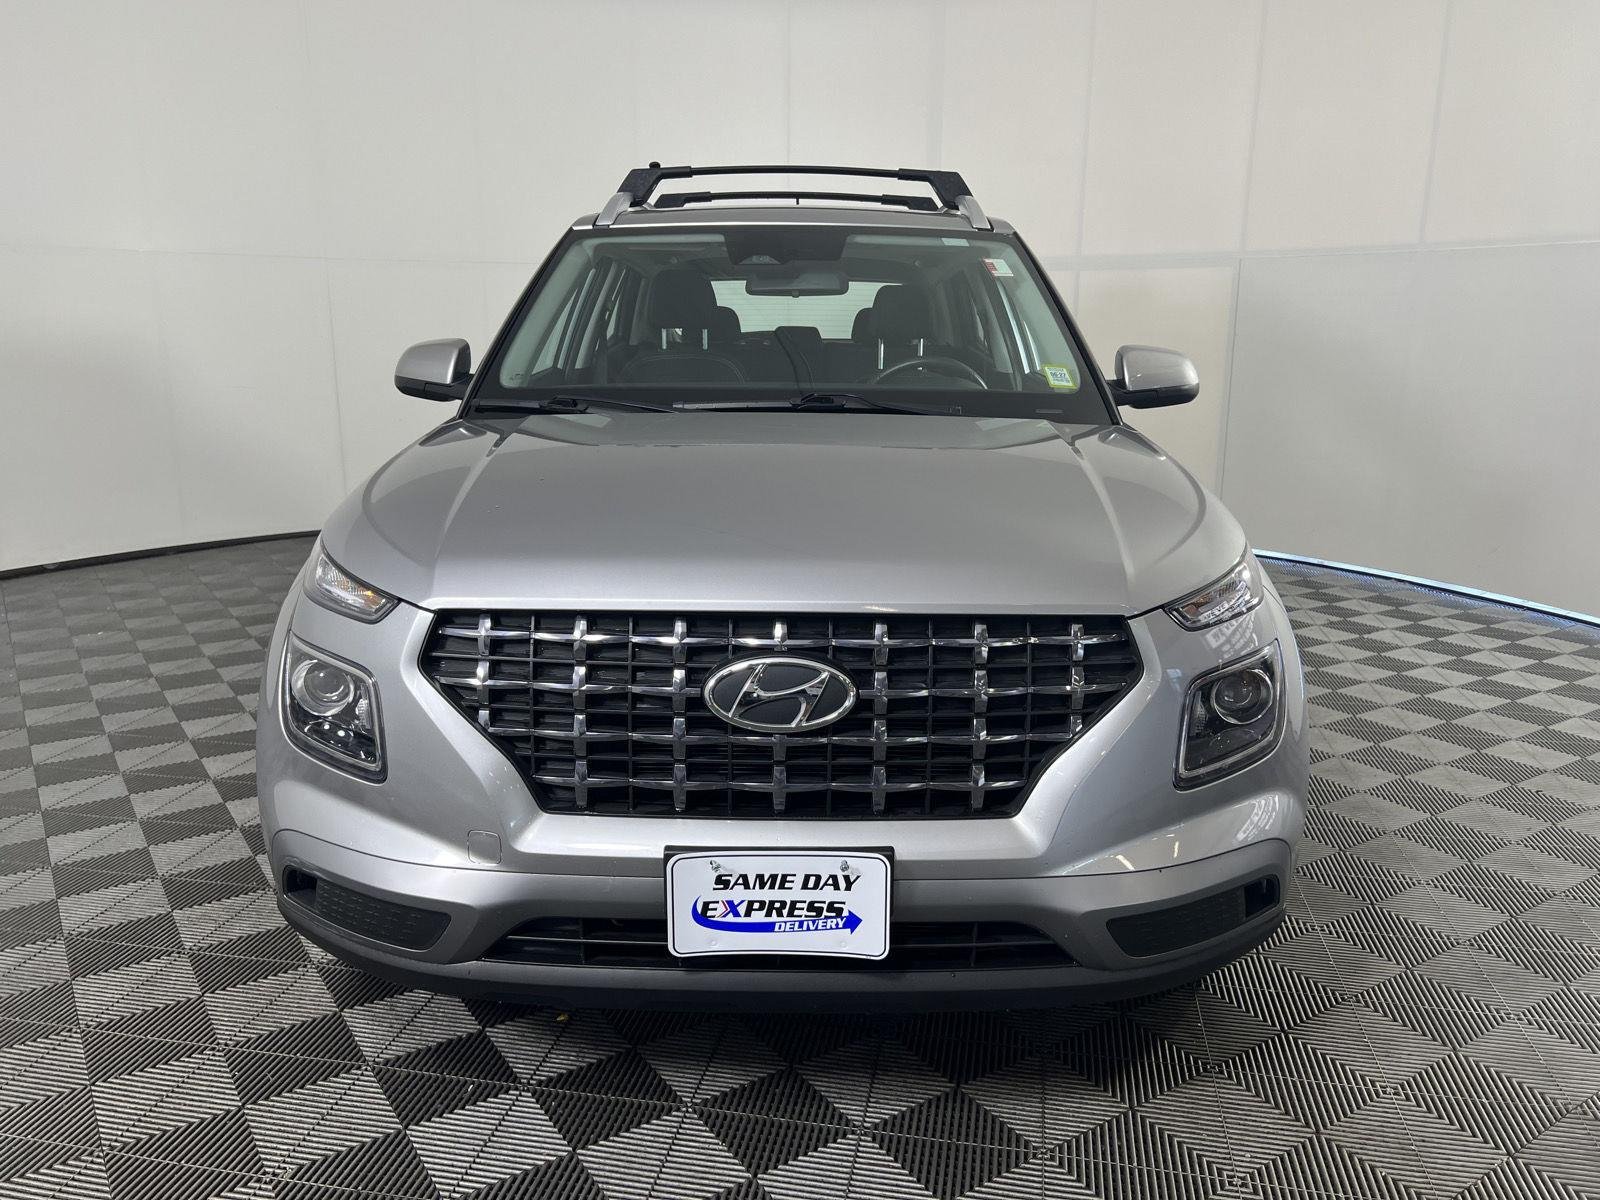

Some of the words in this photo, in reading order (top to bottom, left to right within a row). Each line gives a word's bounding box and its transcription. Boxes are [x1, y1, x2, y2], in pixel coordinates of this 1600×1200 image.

[713, 873, 795, 891] SAME
[801, 874, 861, 891] DAY
[701, 900, 846, 918] EXPRESS
[774, 917, 846, 932] DELIVERY
